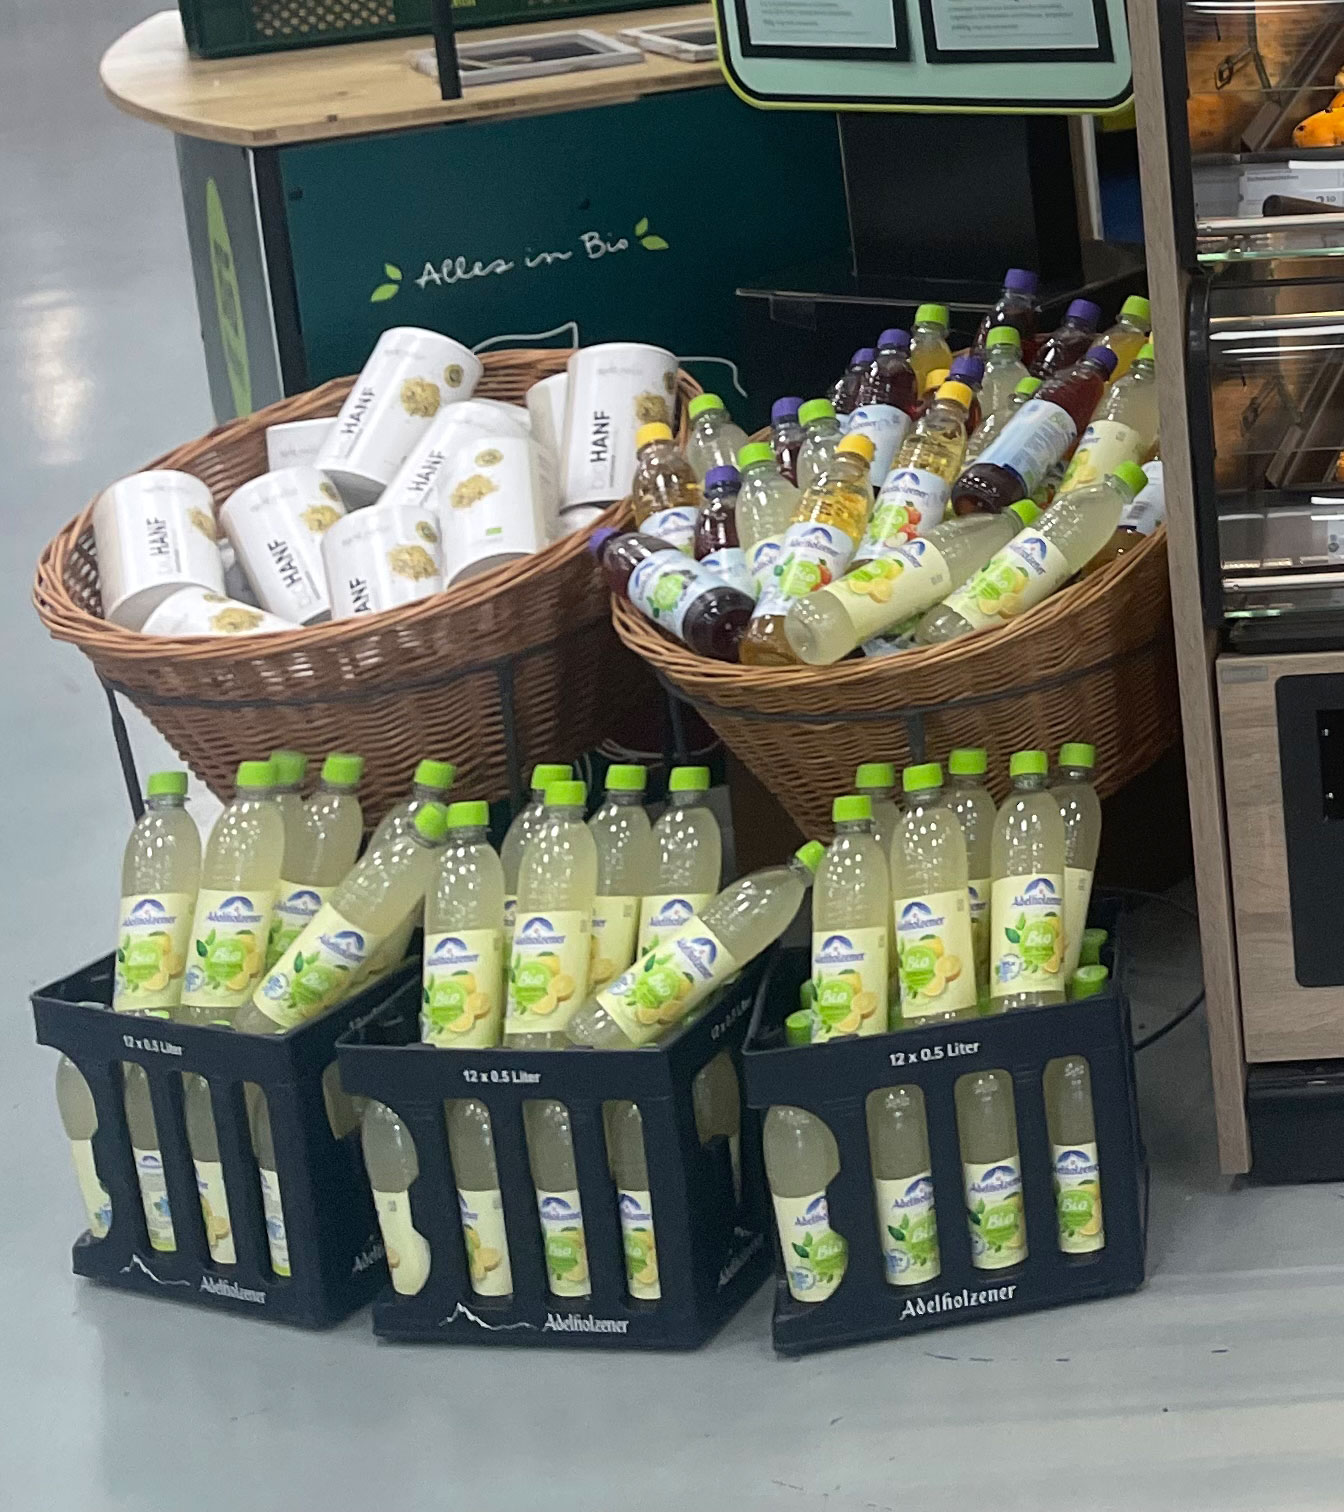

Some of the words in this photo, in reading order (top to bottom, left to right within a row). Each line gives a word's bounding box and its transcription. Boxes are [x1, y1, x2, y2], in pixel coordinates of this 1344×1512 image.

[415, 257, 514, 288] Alles
[525, 248, 572, 268] in
[580, 232, 628, 259] Bio
[341, 387, 375, 435] HANF
[590, 410, 611, 463] HANF
[408, 449, 446, 491] HANF
[146, 517, 170, 556] HANF
[267, 539, 302, 588] HANF
[349, 577, 369, 614] ANF
[123, 1034, 134, 1048] 12
[889, 1053, 905, 1066] 12
[908, 1053, 918, 1063] x
[920, 1047, 944, 1061] 0.5
[947, 1042, 979, 1057] Liter
[463, 1069, 479, 1083] 12
[480, 1072, 489, 1083] x
[490, 1069, 510, 1083] 0.5
[512, 1070, 541, 1083] Liter
[900, 1285, 1017, 1320] Adelholzener
[542, 1313, 628, 1334] Adelholzener
